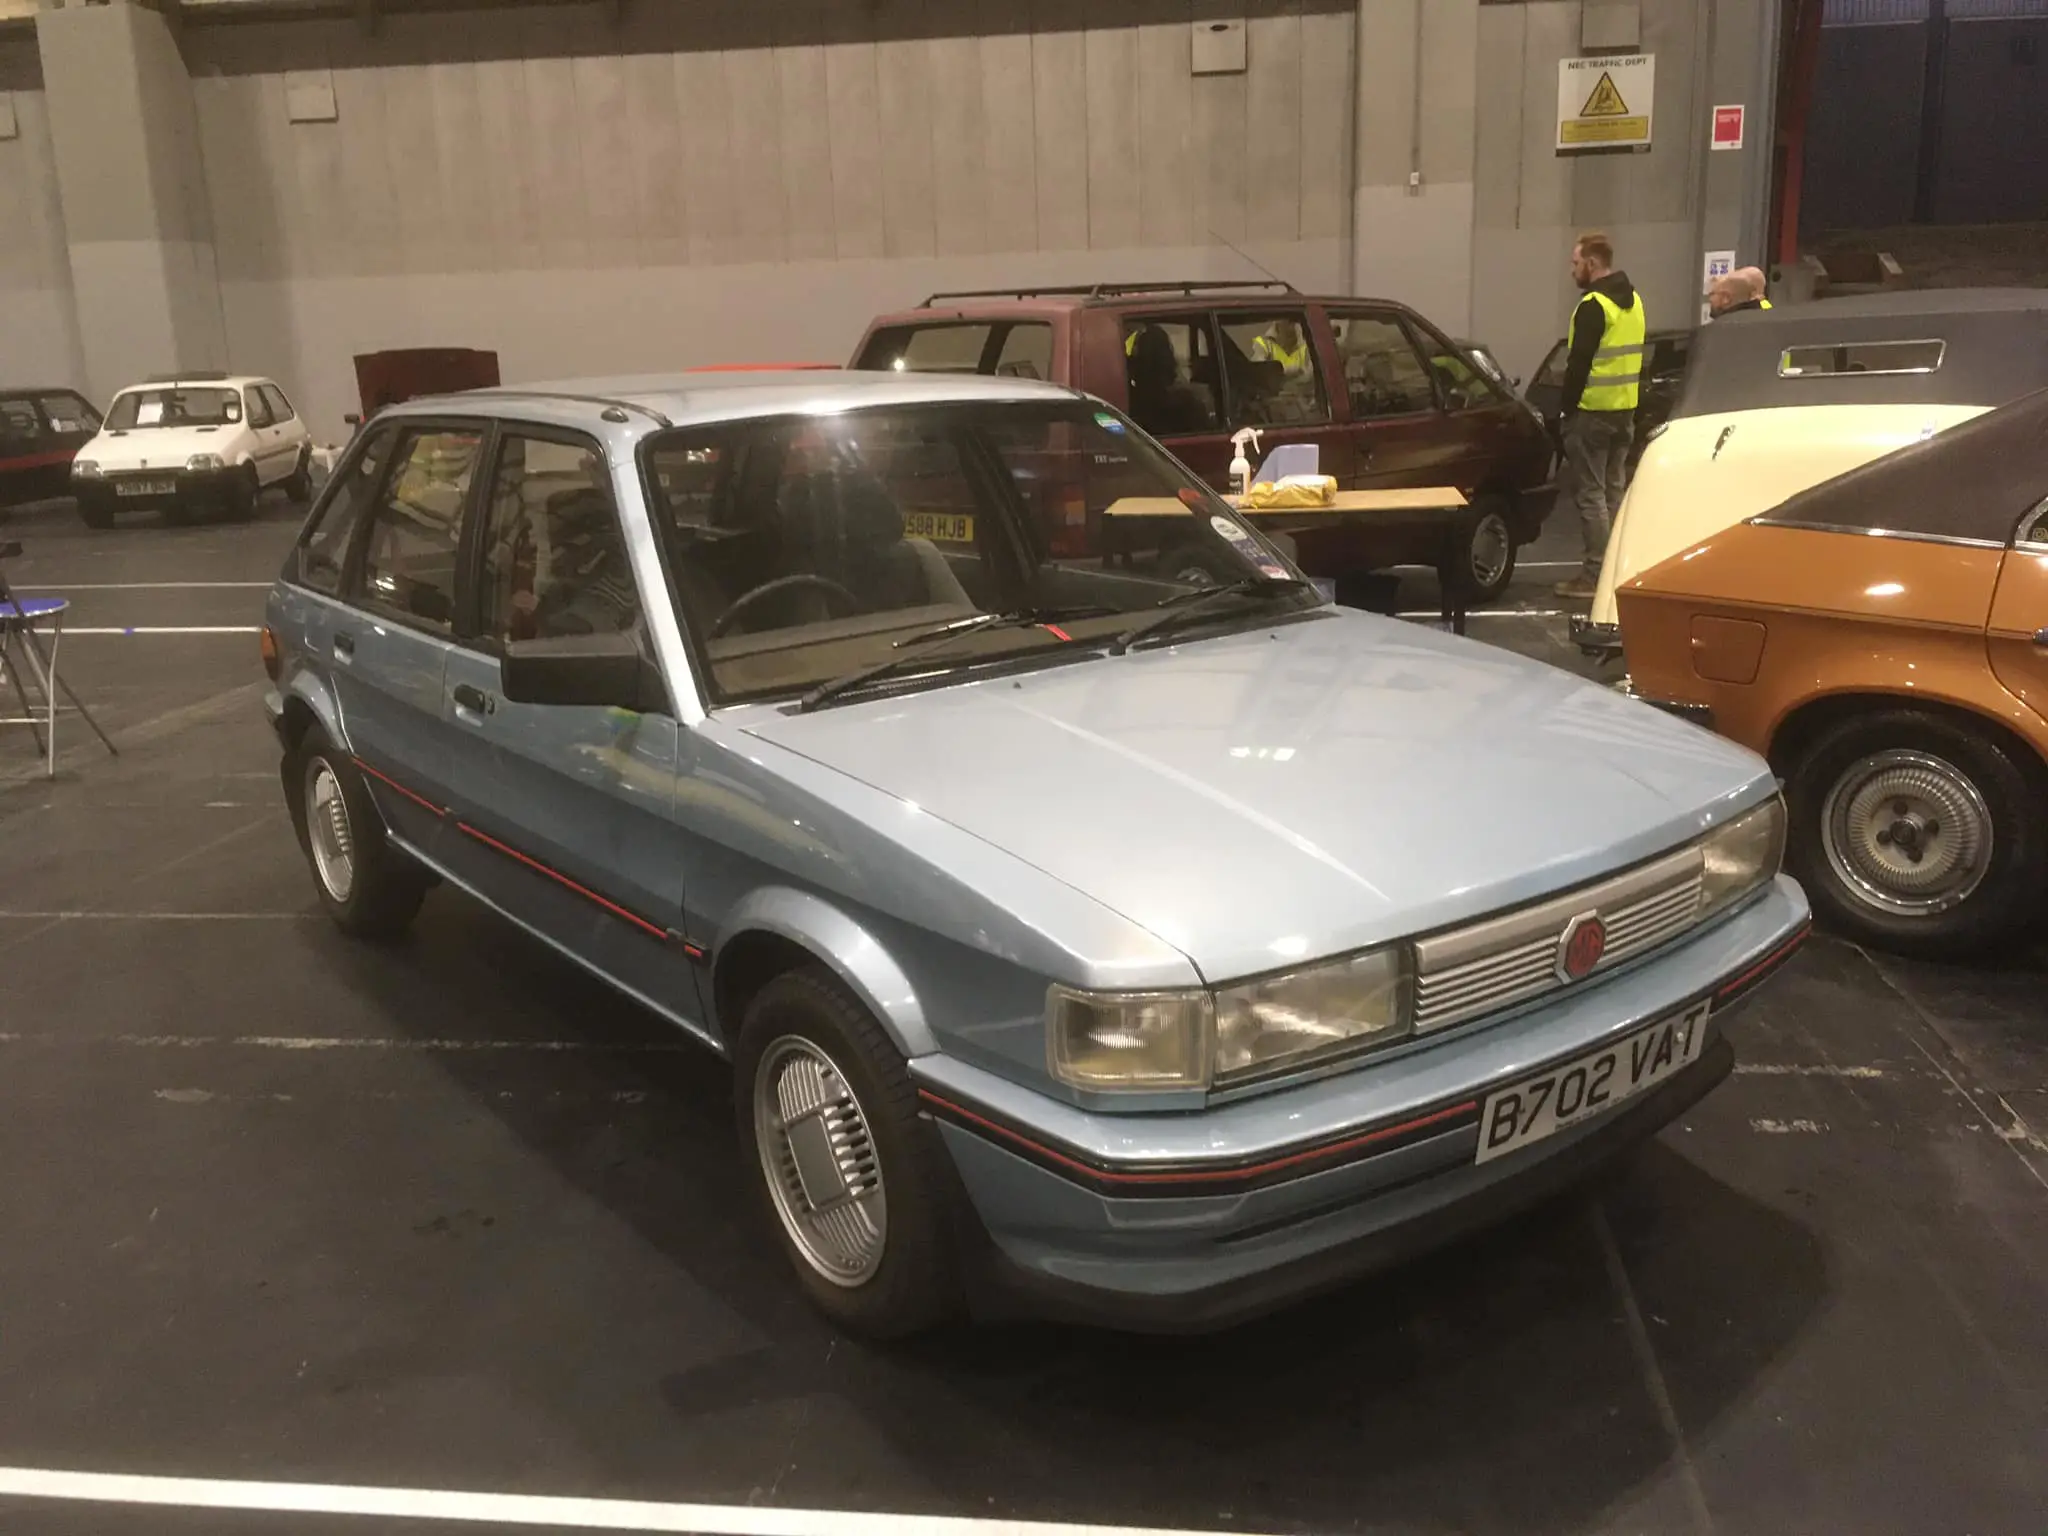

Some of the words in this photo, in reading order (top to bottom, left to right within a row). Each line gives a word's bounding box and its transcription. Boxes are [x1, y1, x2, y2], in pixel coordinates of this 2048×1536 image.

[1568, 62, 1586, 70] NEC
[1589, 59, 1622, 68] TRAFFIC
[1625, 57, 1647, 66] DEPT
[937, 516, 966, 538] HJB
[1487, 1053, 1616, 1149] B702
[1631, 1005, 1706, 1085] VAT
